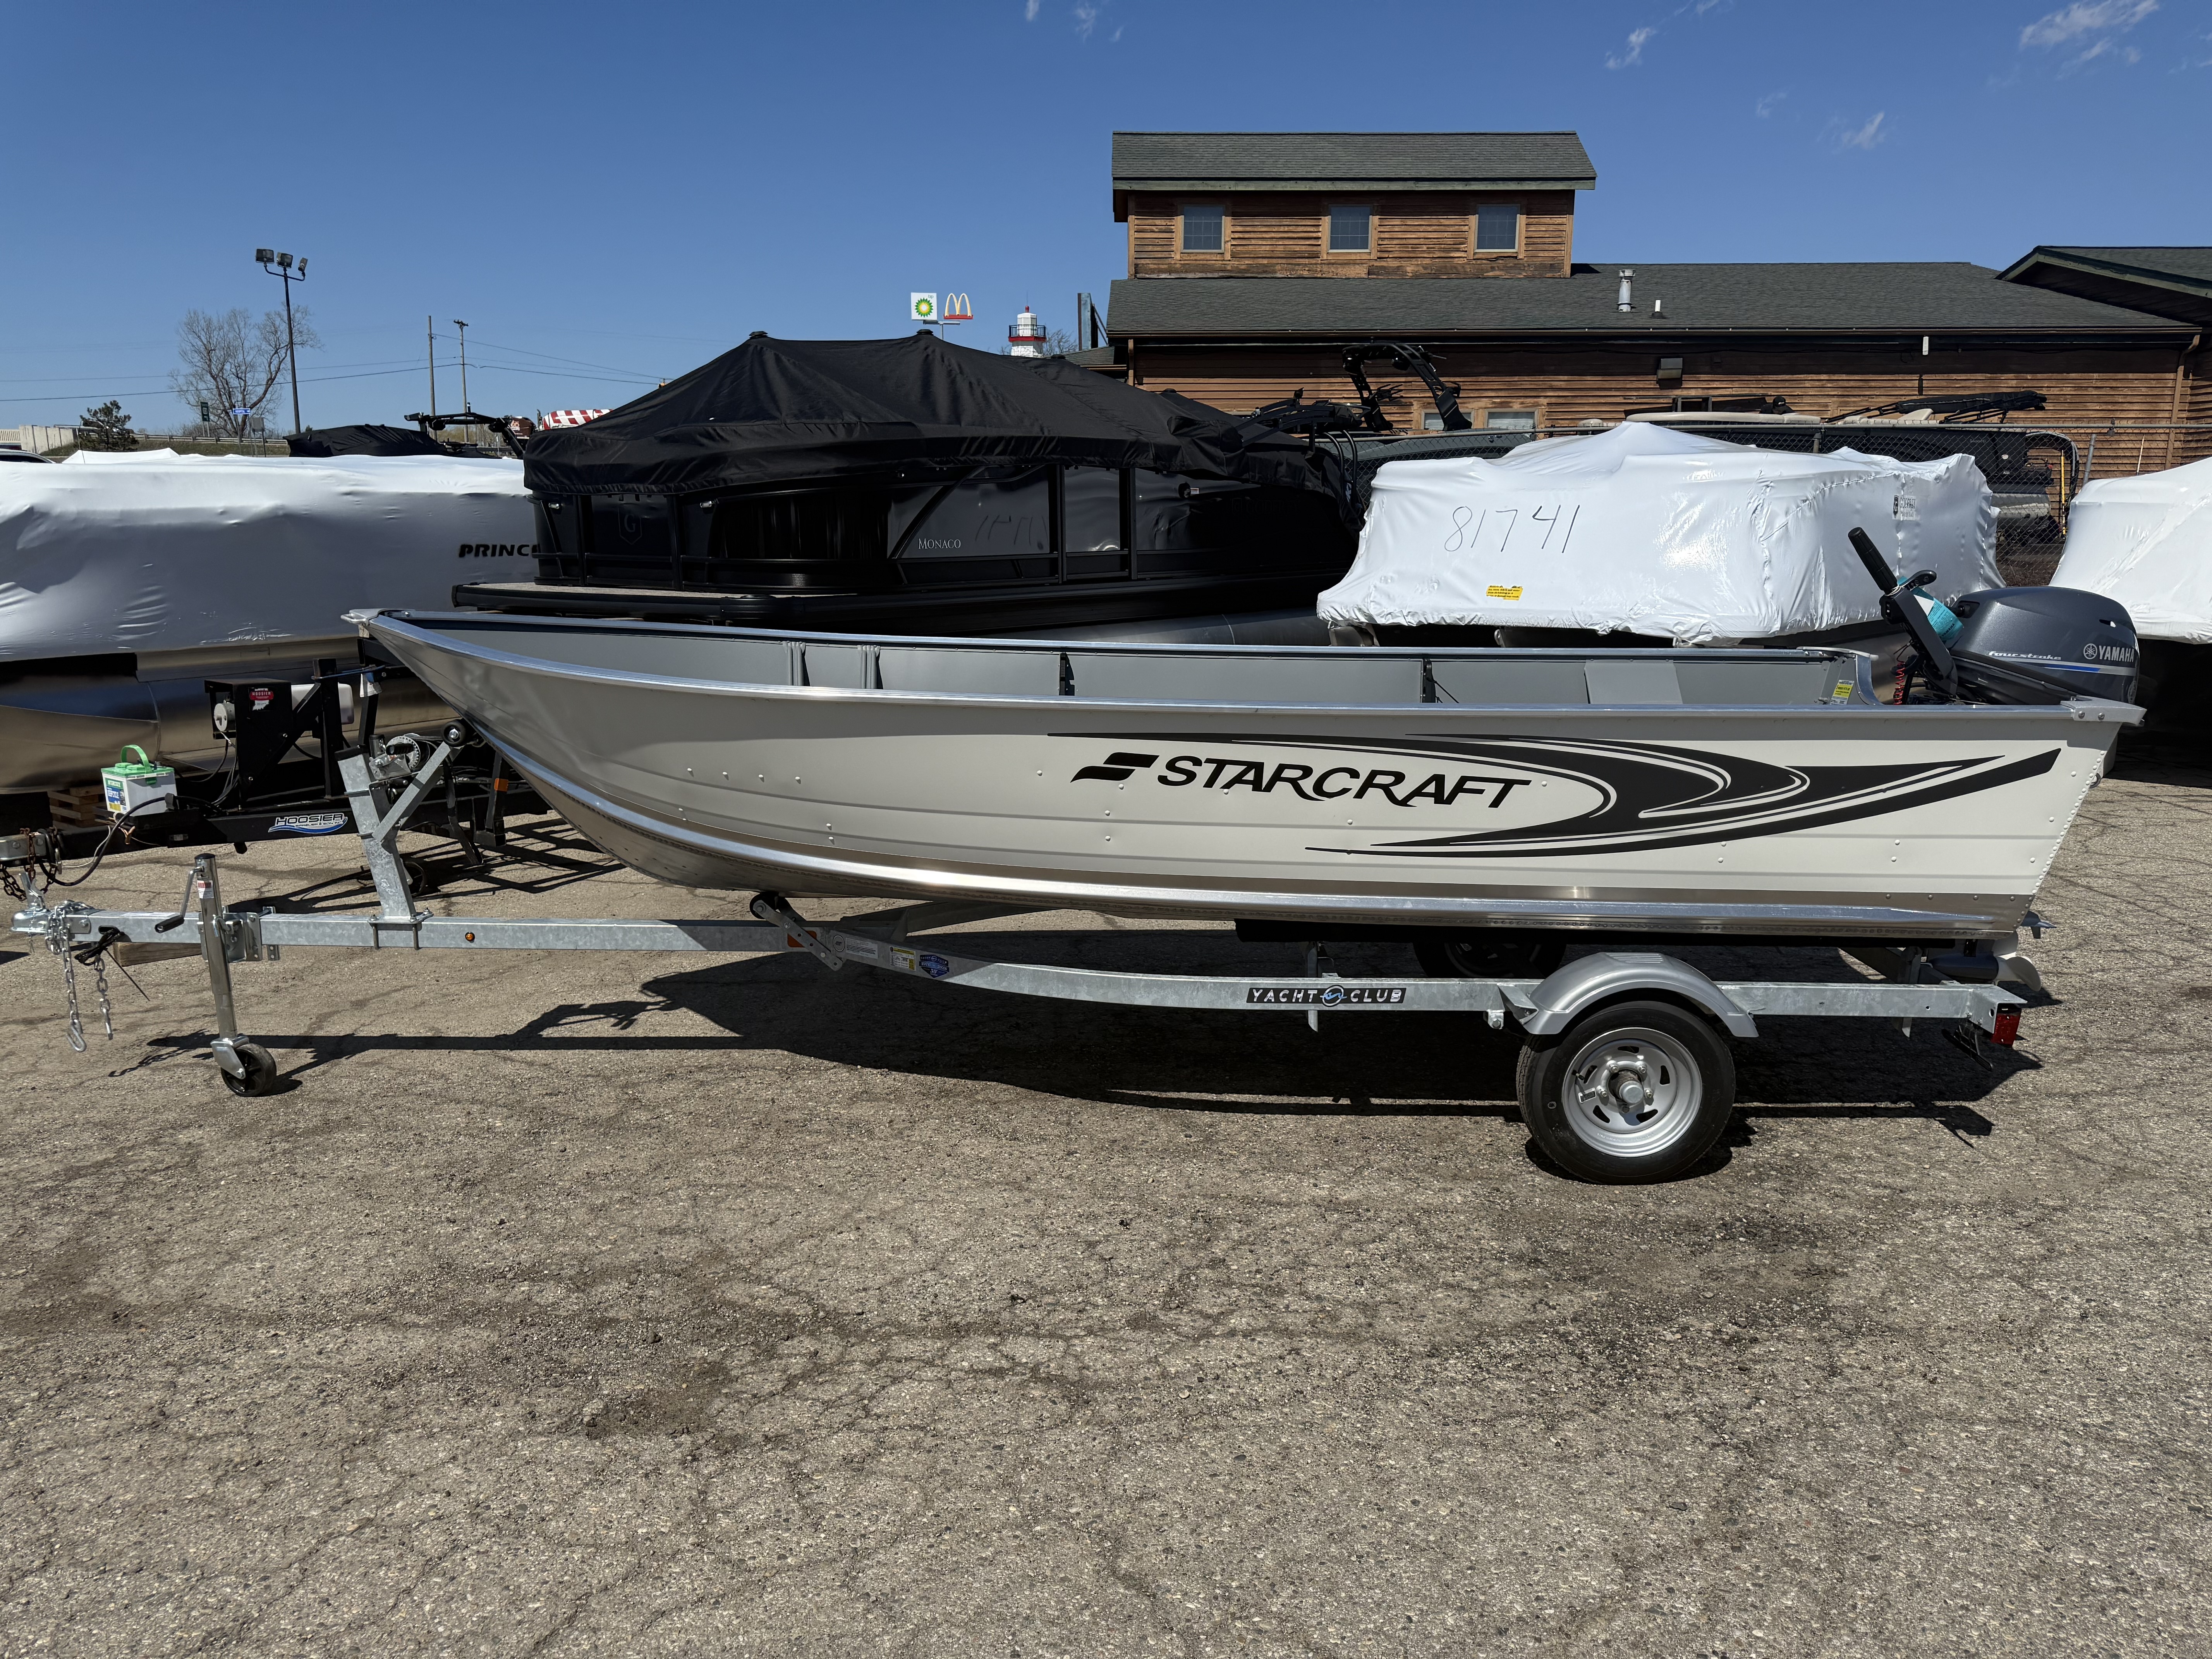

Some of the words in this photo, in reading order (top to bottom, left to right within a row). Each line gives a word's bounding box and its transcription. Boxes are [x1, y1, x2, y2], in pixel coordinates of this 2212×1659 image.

[624, 513, 636, 533] G
[918, 538, 961, 549] MONACO
[2099, 645, 2135, 663] YAMAHA
[1158, 756, 1532, 808] STARCRAFT
[276, 814, 343, 825] HOOSIER
[1253, 989, 1317, 1002] YACHT
[1350, 989, 1402, 1002] CLUB
